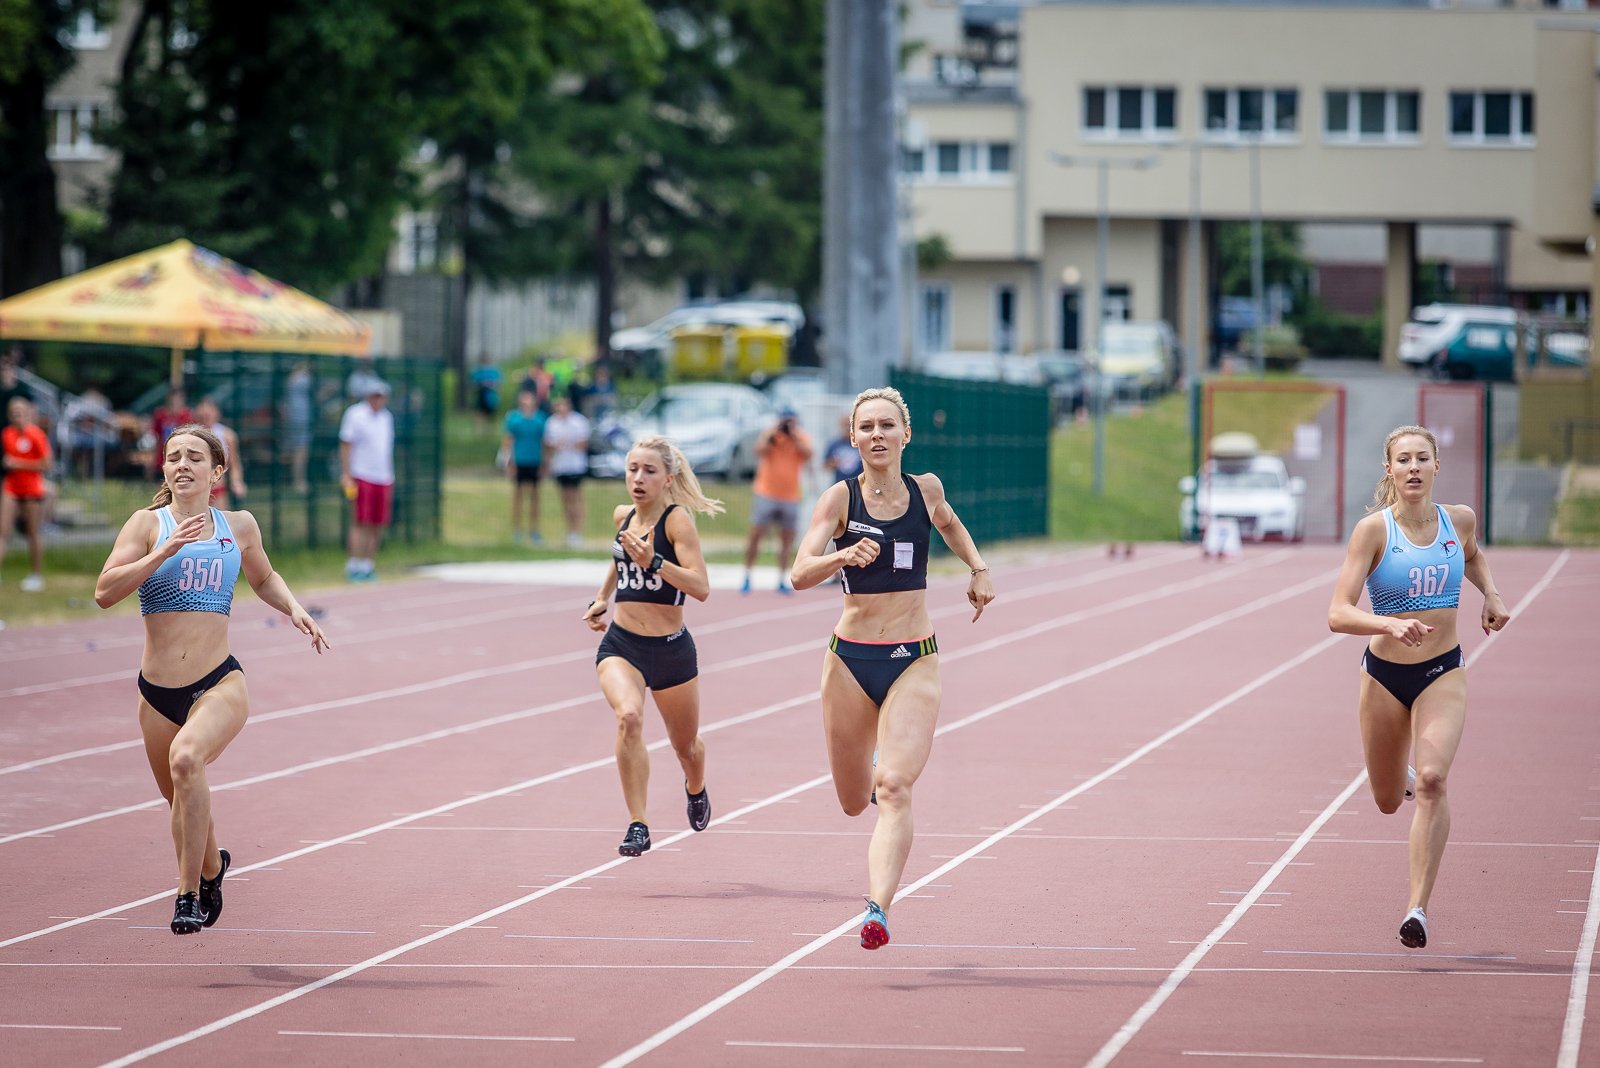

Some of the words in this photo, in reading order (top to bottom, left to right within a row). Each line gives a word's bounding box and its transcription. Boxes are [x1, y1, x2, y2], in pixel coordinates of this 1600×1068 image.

[178, 557, 223, 593] 354
[616, 561, 663, 591] 333
[1408, 563, 1450, 598] 367
[890, 651, 911, 659] adidas
